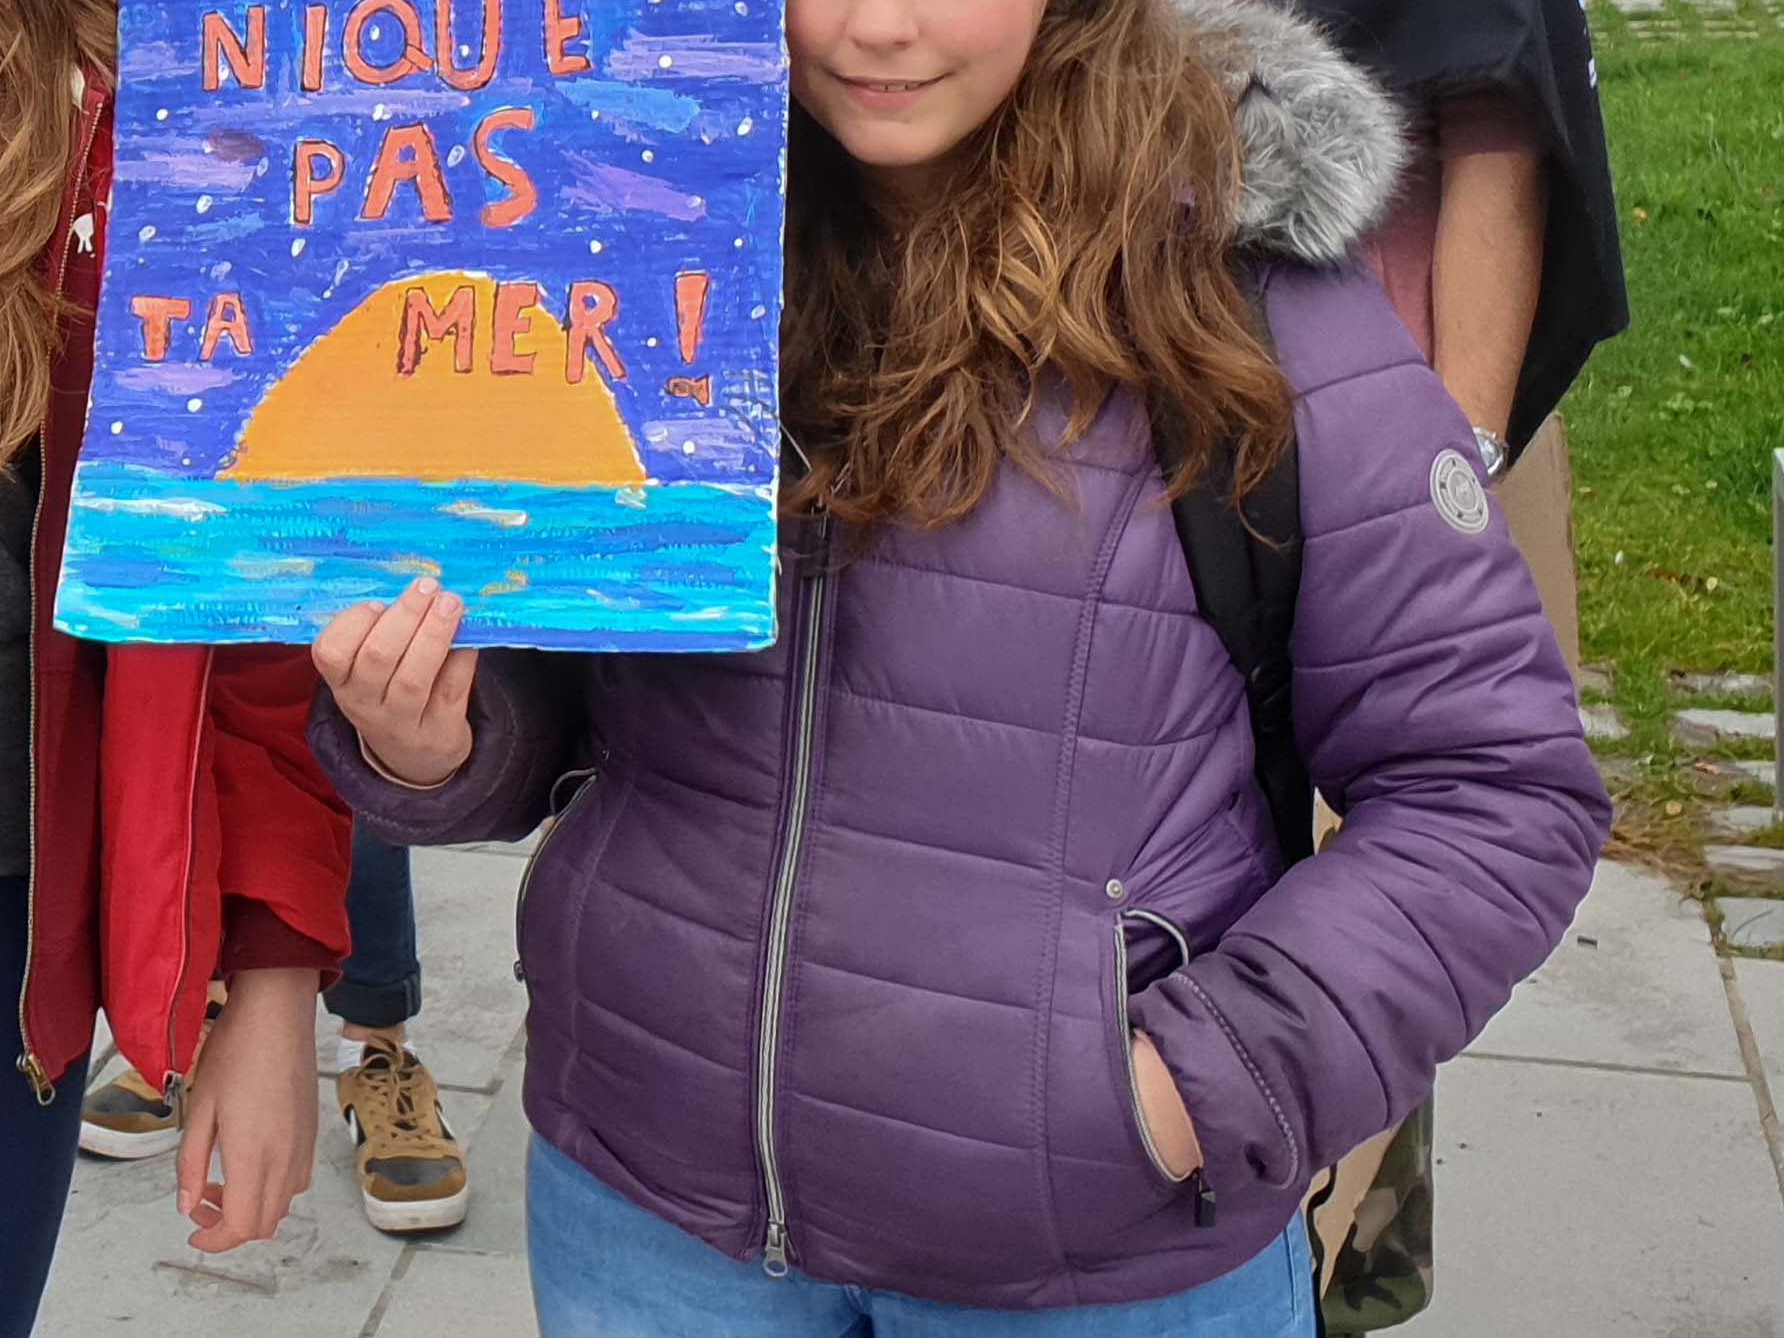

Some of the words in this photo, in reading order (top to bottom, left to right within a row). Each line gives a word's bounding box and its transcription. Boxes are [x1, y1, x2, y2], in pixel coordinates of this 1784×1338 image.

[291, 107, 540, 228] PAS
[130, 292, 255, 363] TA
[394, 280, 628, 385] MER
